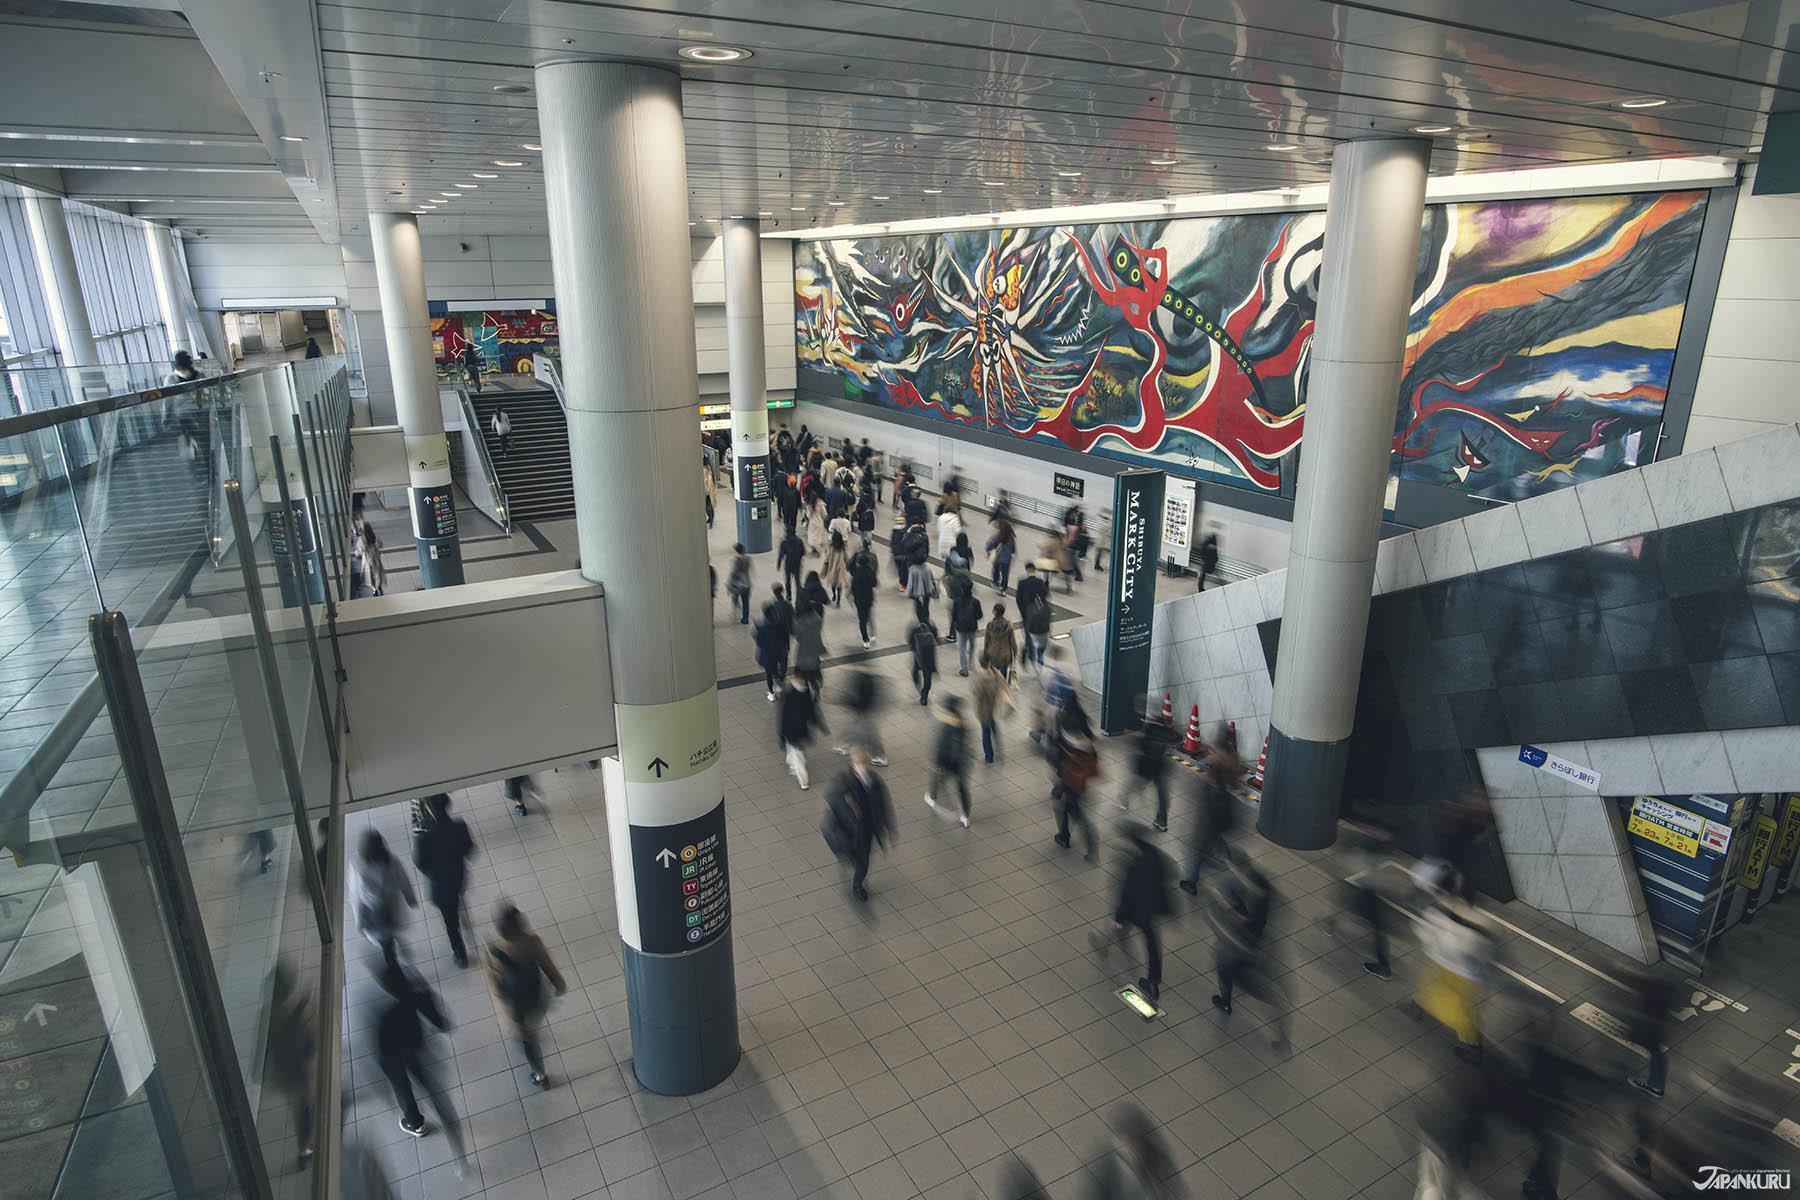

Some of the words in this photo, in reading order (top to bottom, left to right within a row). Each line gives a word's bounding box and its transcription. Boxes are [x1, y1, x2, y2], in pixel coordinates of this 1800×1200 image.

[1128, 491, 1141, 548] MARK
[1136, 518, 1145, 571] SHIBUYA
[1125, 552, 1136, 600] CITY
[1551, 761, 1595, 784] きらぼし銀行
[685, 866, 696, 876] JR
[687, 883, 696, 891] TY
[688, 914, 698, 923] DT
